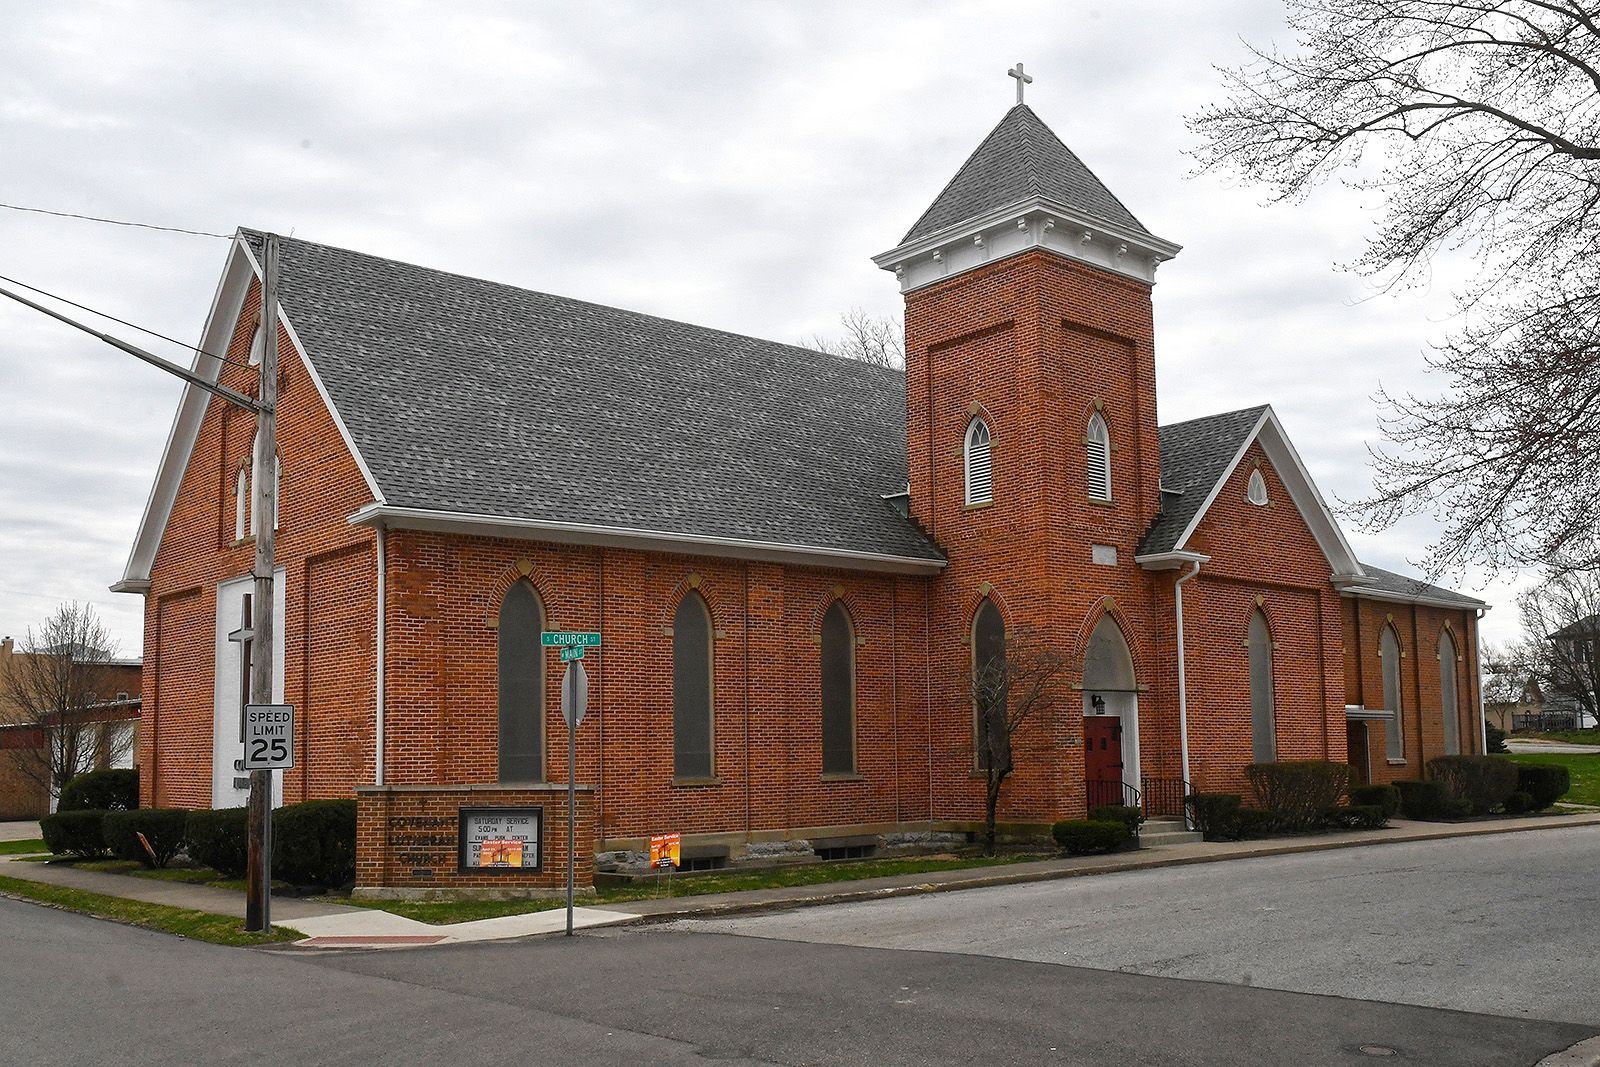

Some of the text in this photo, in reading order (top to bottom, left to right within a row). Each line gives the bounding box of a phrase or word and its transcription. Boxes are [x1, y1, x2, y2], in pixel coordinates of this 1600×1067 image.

[553, 634, 588, 645] CHURCH
[249, 712, 290, 722] SPEED
[253, 725, 285, 735] LIMIT
[250, 738, 288, 762] 25
[474, 817, 529, 825] SATURDAY SERVICE
[388, 834, 458, 847] LUTHERAN
[400, 852, 446, 866] CHURCH
